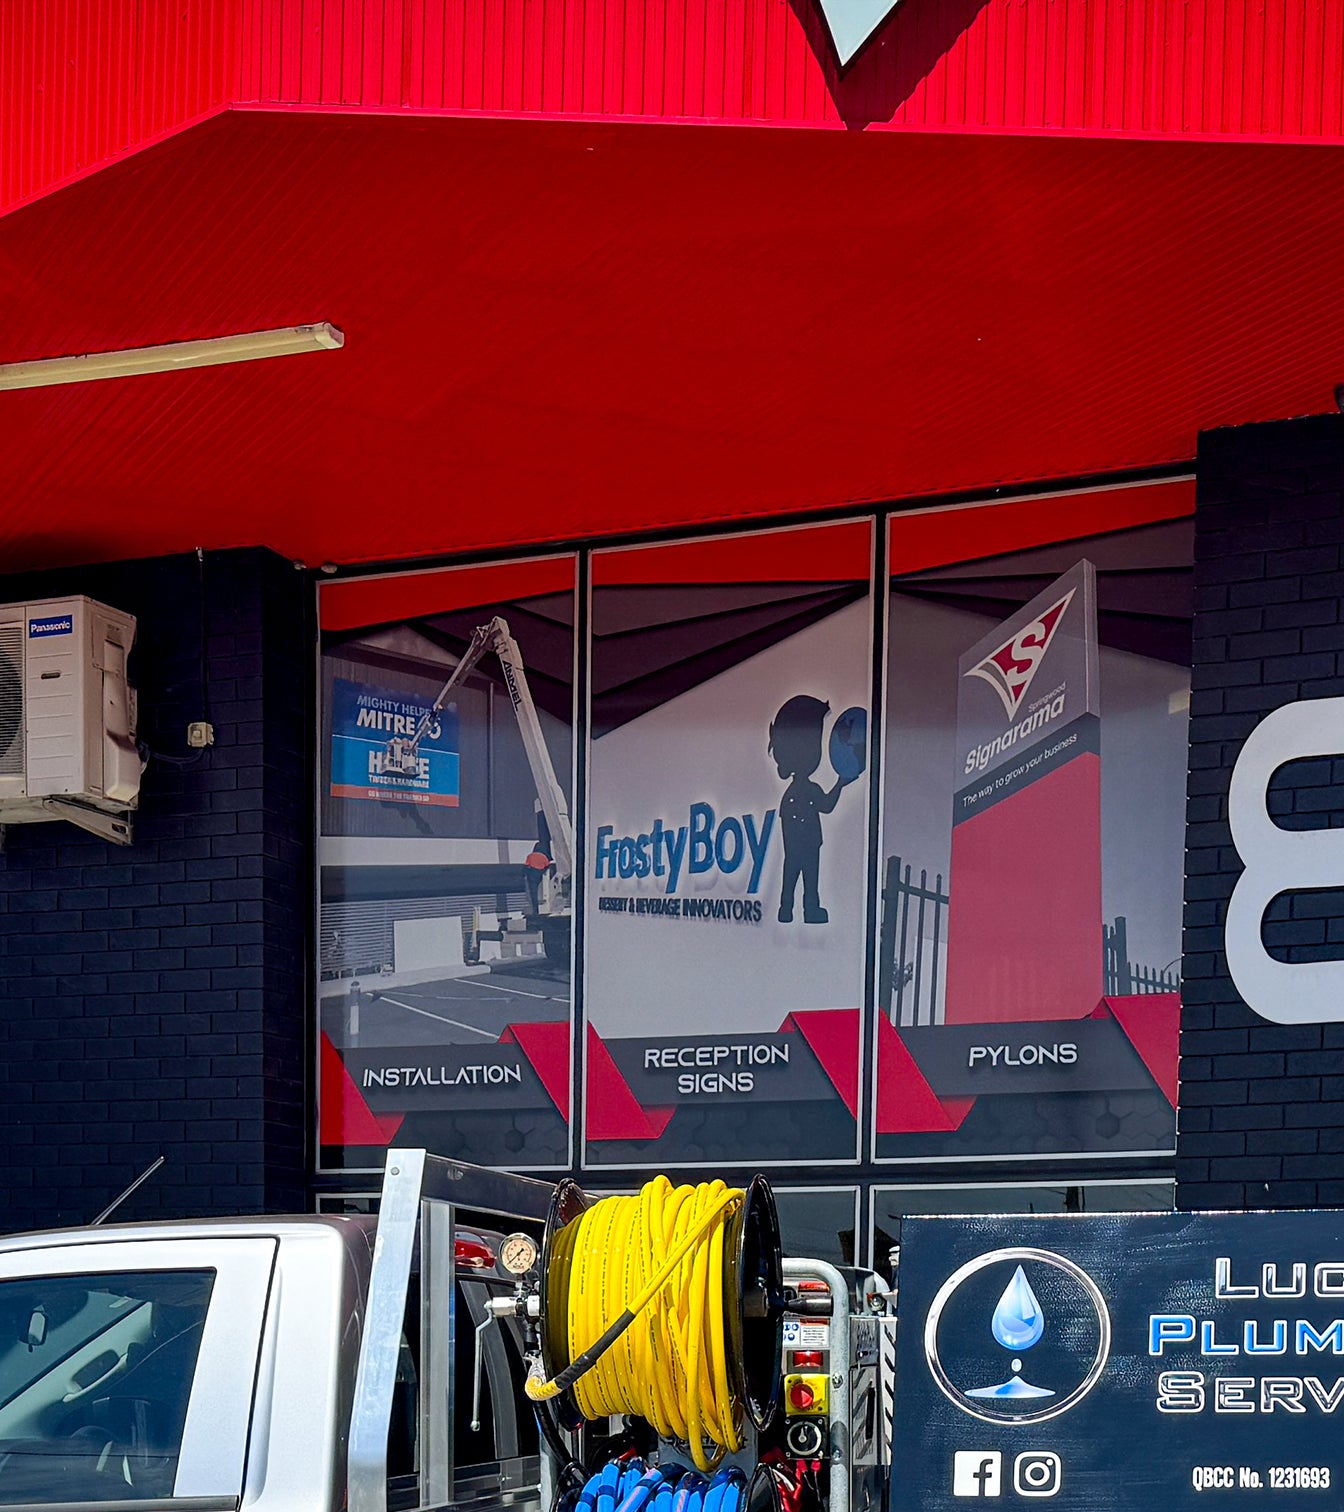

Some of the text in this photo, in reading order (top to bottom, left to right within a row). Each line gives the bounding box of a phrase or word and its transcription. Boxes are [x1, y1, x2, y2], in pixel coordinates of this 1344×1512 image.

[30, 621, 71, 634] Panasonic
[356, 695, 399, 712] MIGHTY
[1029, 681, 1066, 712] Springwood
[356, 708, 415, 735] MITRE
[965, 694, 1065, 774] Signarama
[963, 733, 1077, 807] The way to grow your business
[595, 802, 776, 894] FrostyBoy
[599, 897, 628, 912] DESSERT
[636, 898, 681, 916] BEVERAGE
[682, 899, 762, 922] INNOVATORS
[645, 1043, 789, 1069] RECEPTION
[968, 1042, 1078, 1068] PYLONS
[363, 1064, 522, 1088] INSTALLATION
[677, 1071, 754, 1094] SIGNS
[1192, 1466, 1330, 1491] QBCC No. 1231693
